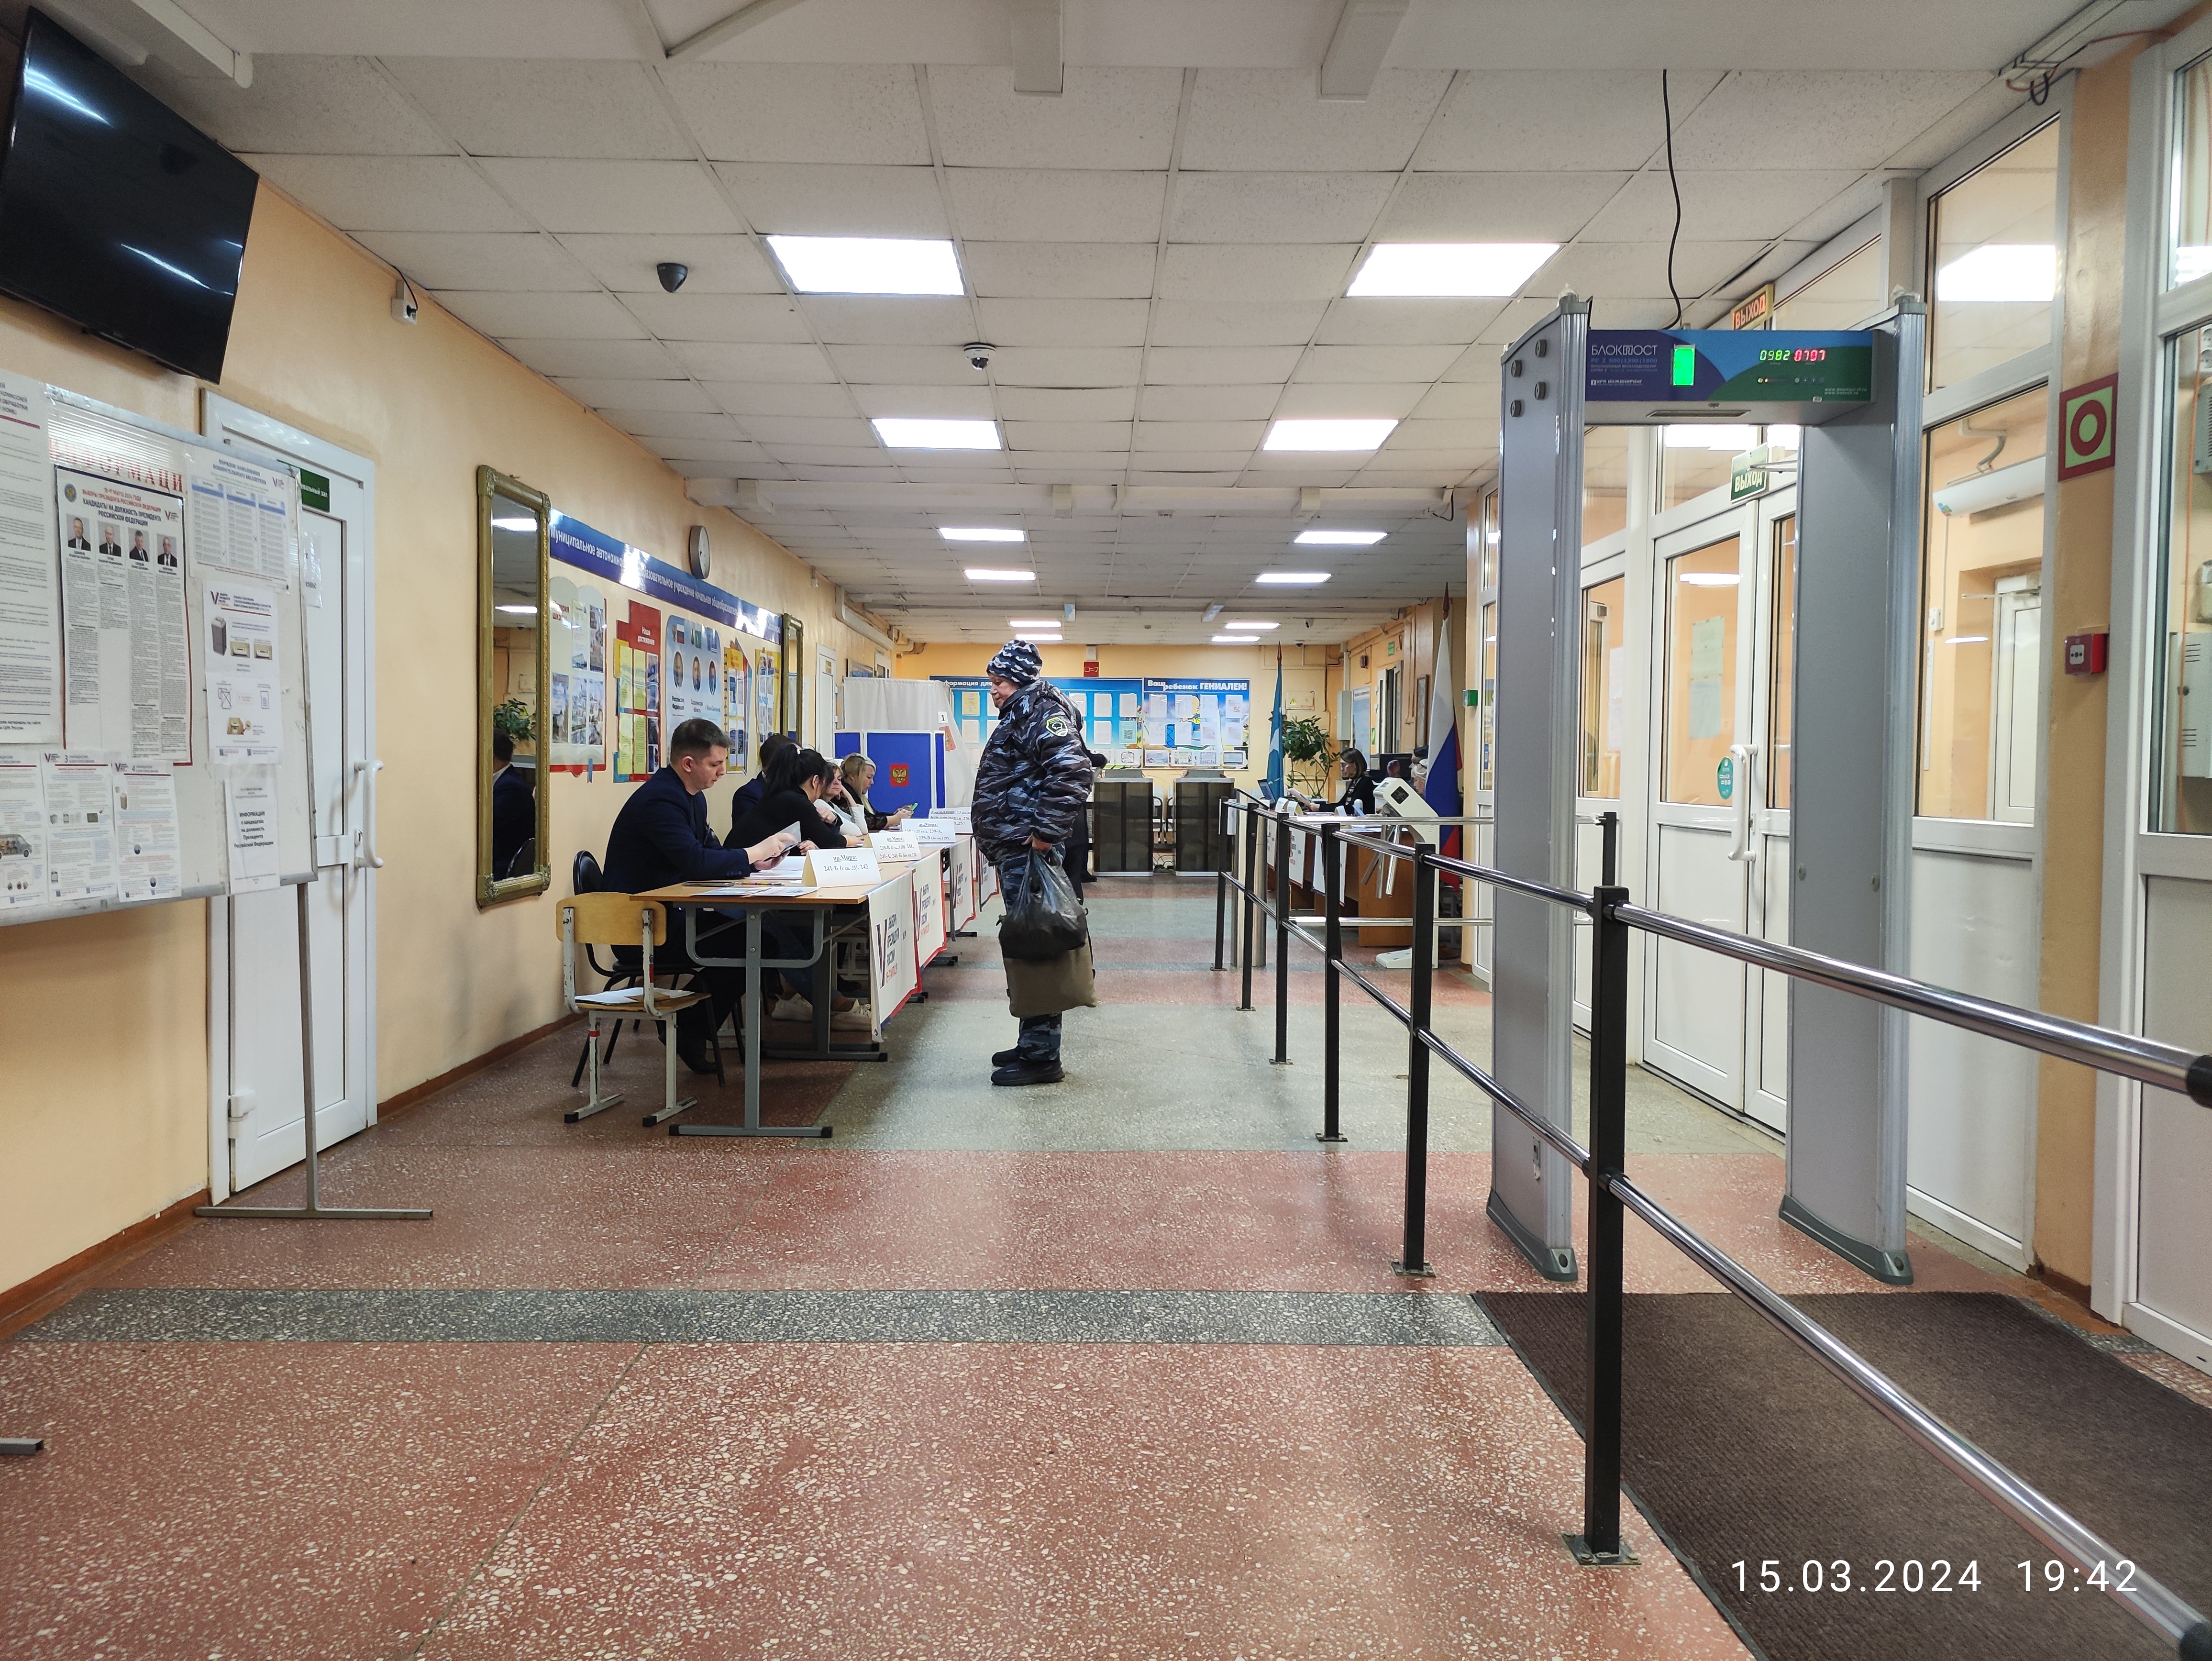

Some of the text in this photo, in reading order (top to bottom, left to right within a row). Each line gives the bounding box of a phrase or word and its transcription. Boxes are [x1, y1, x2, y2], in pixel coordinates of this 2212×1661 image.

[1736, 294, 1766, 330] ВЫХОД
[1592, 345, 1658, 355] БЛОКПОСТ
[1759, 349, 1791, 361] 0982
[48, 438, 184, 493] ИНФОРМАЦИ
[1735, 471, 1763, 492] ВЫХОД
[83, 498, 108, 509] КАНДИДАТЫ
[114, 505, 138, 516] ДОЛЖНОСТЬ
[139, 511, 162, 522] ПРЕЗИДЕНТА
[99, 510, 124, 521] РОССИЙСКОЙ
[551, 527, 595, 556] Муниципальное
[597, 547, 622, 567] автономно
[1163, 682, 1247, 691] ребенок ГЕНИАЛЕН!
